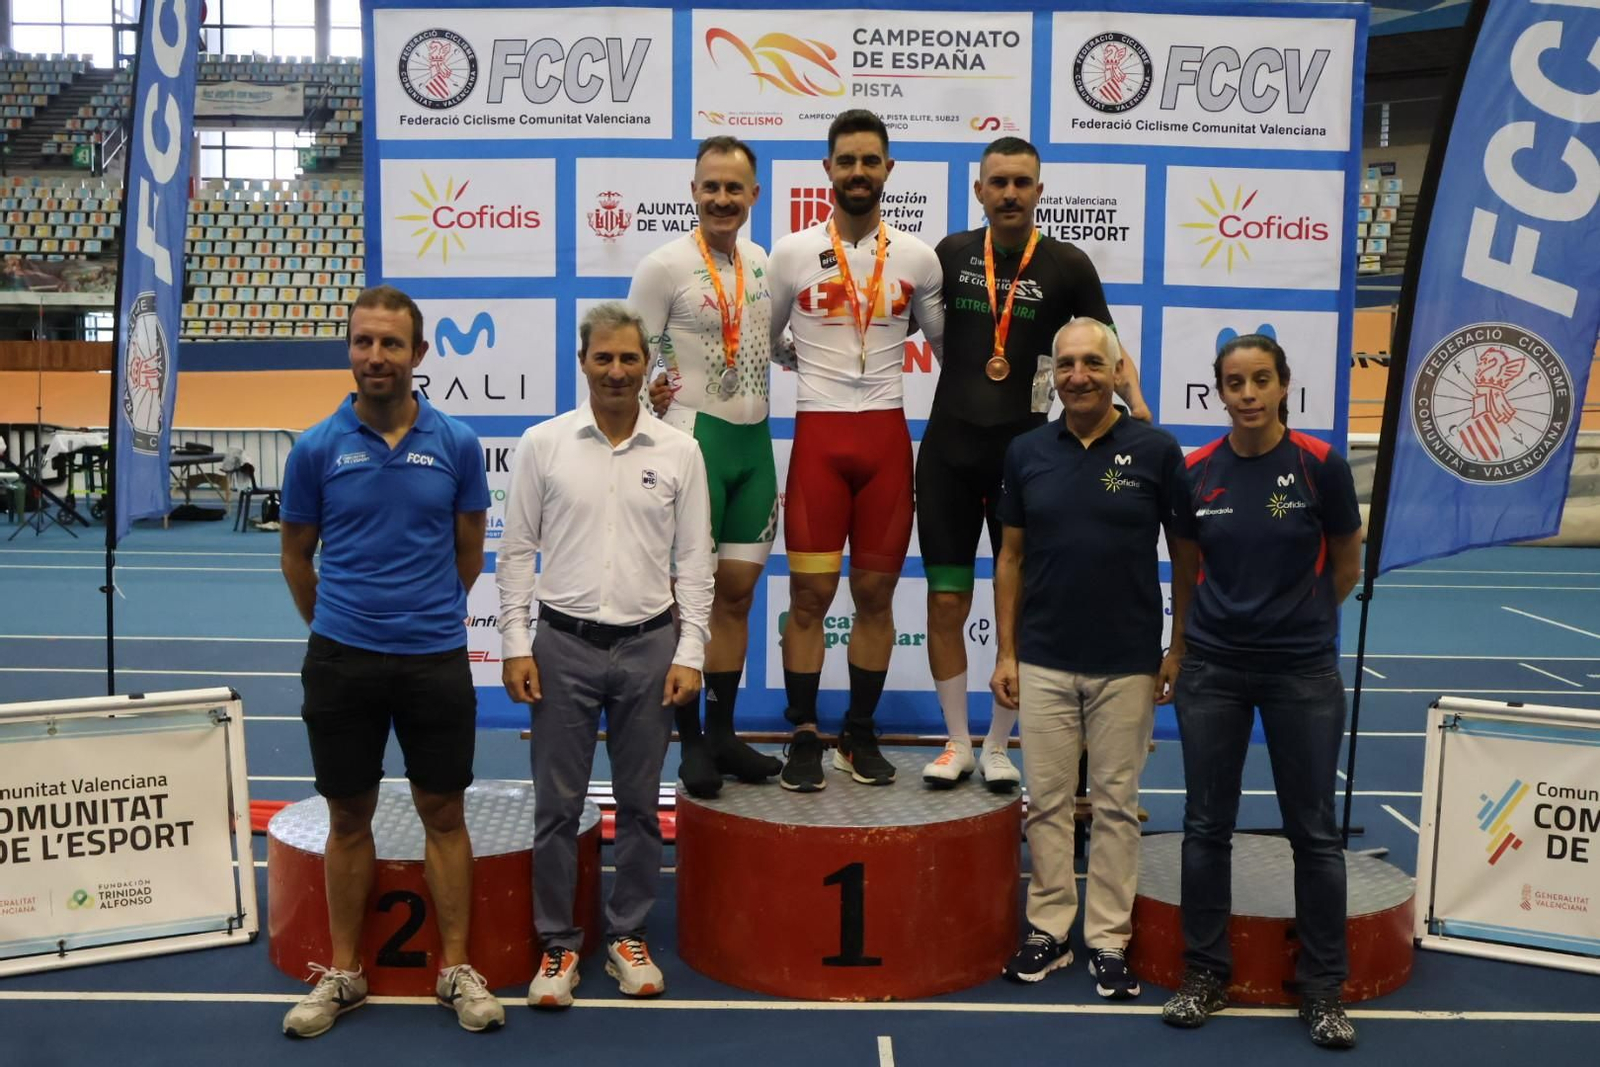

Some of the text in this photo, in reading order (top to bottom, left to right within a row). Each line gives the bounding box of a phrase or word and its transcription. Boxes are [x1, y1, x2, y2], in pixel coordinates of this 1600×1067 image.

[852, 28, 1020, 48] CAMPEONATO
[1077, 34, 1150, 64] FEDERACIÓ CICLISME
[852, 50, 986, 70] DE ESPAÑA
[487, 37, 652, 104] FCCV
[1160, 46, 1331, 114] FCCV
[852, 83, 904, 98] PISTA
[400, 113, 651, 126] Federació Ciclisme Comunitat Valenciana
[728, 116, 783, 126] CICLISMO
[1072, 118, 1326, 136] Federació Ciclisme Comunitat Valenciana
[1462, 0, 1600, 318] FCC
[637, 202, 698, 215] AJUNTA
[1065, 196, 1117, 206] Valenciana
[432, 206, 540, 229] Cofidis
[638, 220, 657, 232] DE
[1035, 208, 1117, 224] MUNITAT
[1048, 226, 1130, 242] L'ESPORT
[1219, 214, 1329, 241] Cofidis
[960, 274, 969, 283] DE
[1425, 328, 1568, 398] FEDERACIÓ CICLISME
[406, 452, 434, 466] FCCV
[1484, 421, 1564, 477] VALENCIANA
[1276, 500, 1306, 509] Cofidis
[72, 774, 168, 794] Valenciana
[1536, 782, 1599, 802] Comun
[0, 794, 168, 834] OMUNITAT
[1534, 803, 1600, 833] COM
[42, 820, 194, 860] L'ESPORT
[1546, 834, 1590, 864] DE
[98, 886, 152, 900] TRINIDAD
[100, 896, 152, 910] ALFONSO
[1535, 891, 1590, 904] GENERALITAT
[821, 862, 882, 967] 1
[1535, 900, 1588, 912] VALENCIANA
[376, 890, 428, 968] 2
